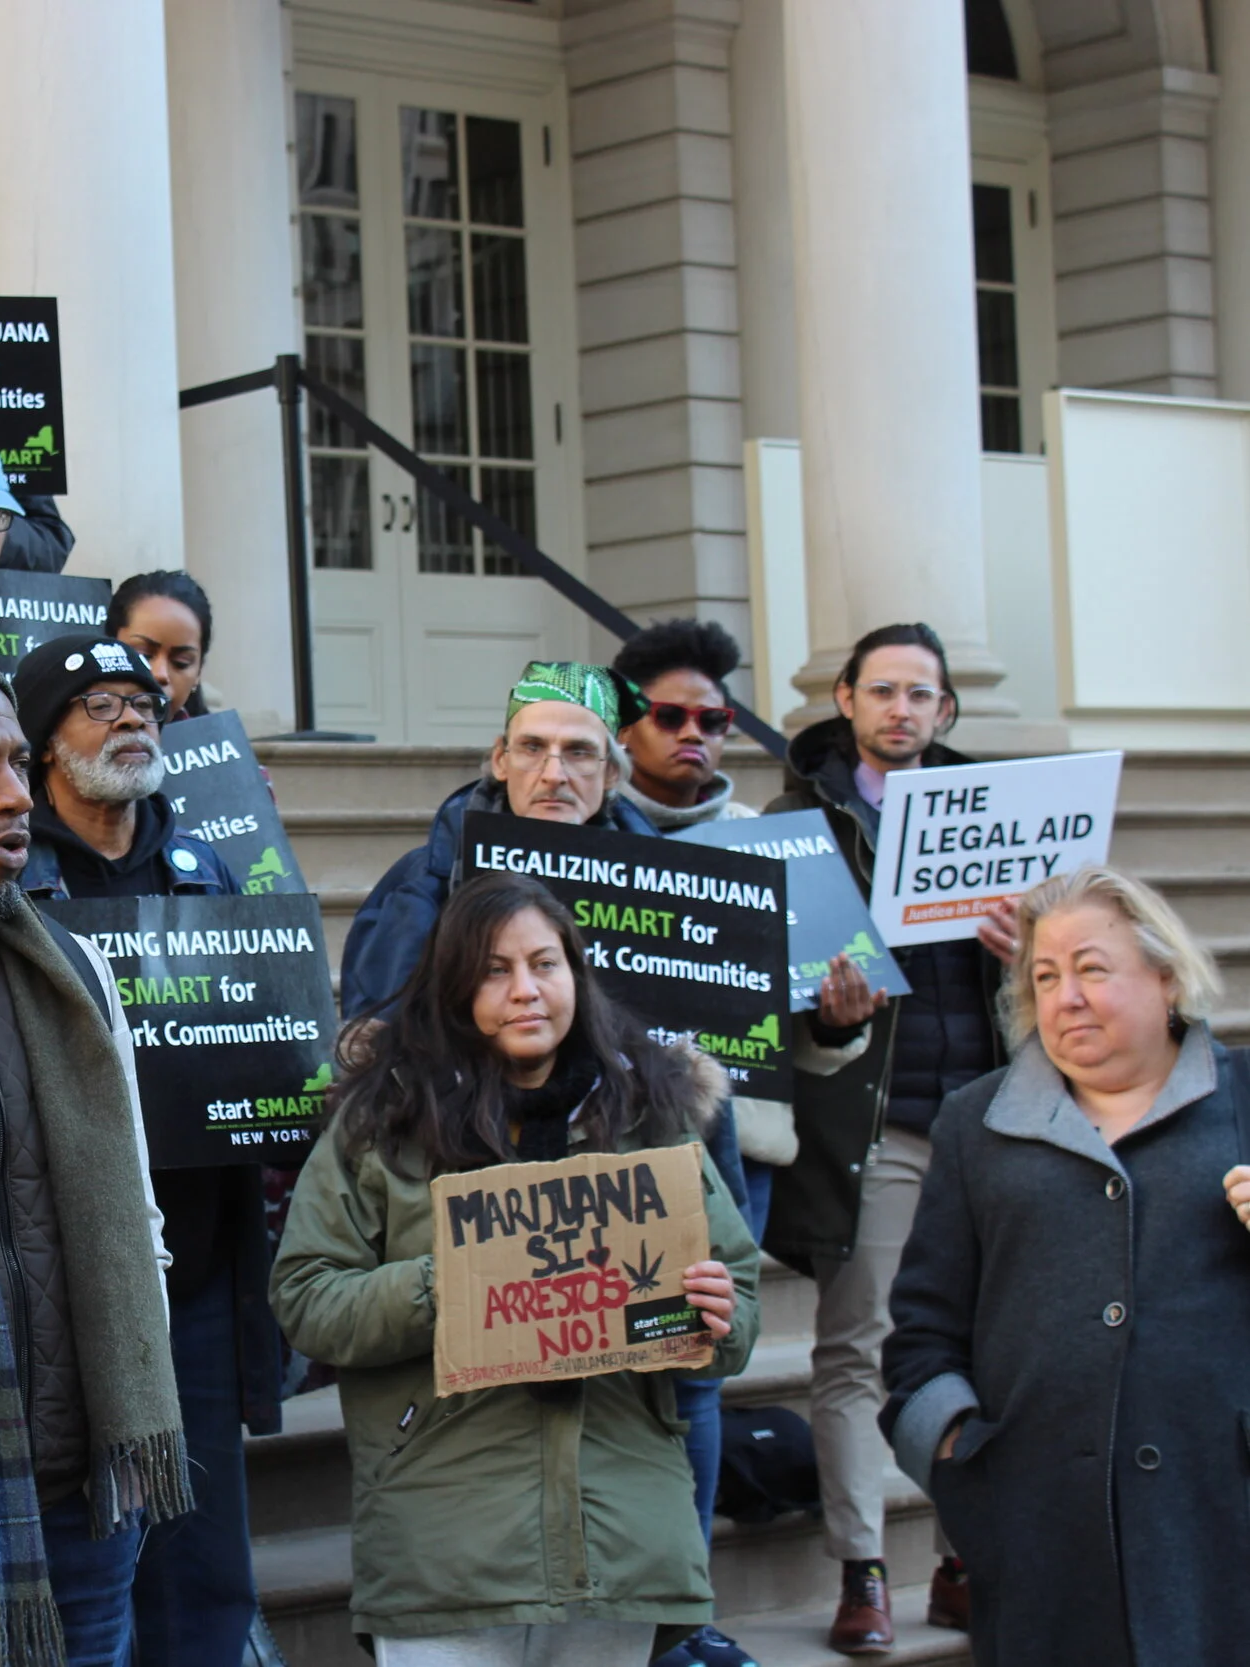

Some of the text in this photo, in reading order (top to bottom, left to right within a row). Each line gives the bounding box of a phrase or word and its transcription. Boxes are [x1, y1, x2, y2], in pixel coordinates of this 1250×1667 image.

[924, 785, 990, 817] THE
[917, 813, 1093, 856] LEGAL AID
[475, 843, 778, 913] LEGALIZING MARIJUANA
[912, 853, 1061, 893] SOCIETY
[574, 899, 718, 945] SMART for
[166, 927, 314, 957] MARIJUANA
[615, 946, 772, 993] Communities
[117, 975, 257, 1006] SMART for
[164, 1015, 320, 1046] Communities
[698, 1032, 769, 1061] SMART
[207, 1095, 325, 1121] start SMART
[230, 1129, 311, 1145] NEW YORK
[446, 1162, 668, 1248] MARIJUANA
[483, 1267, 630, 1330] ARRESTOS
[537, 1309, 611, 1363] NO!
[644, 1330, 664, 1339] NEW
